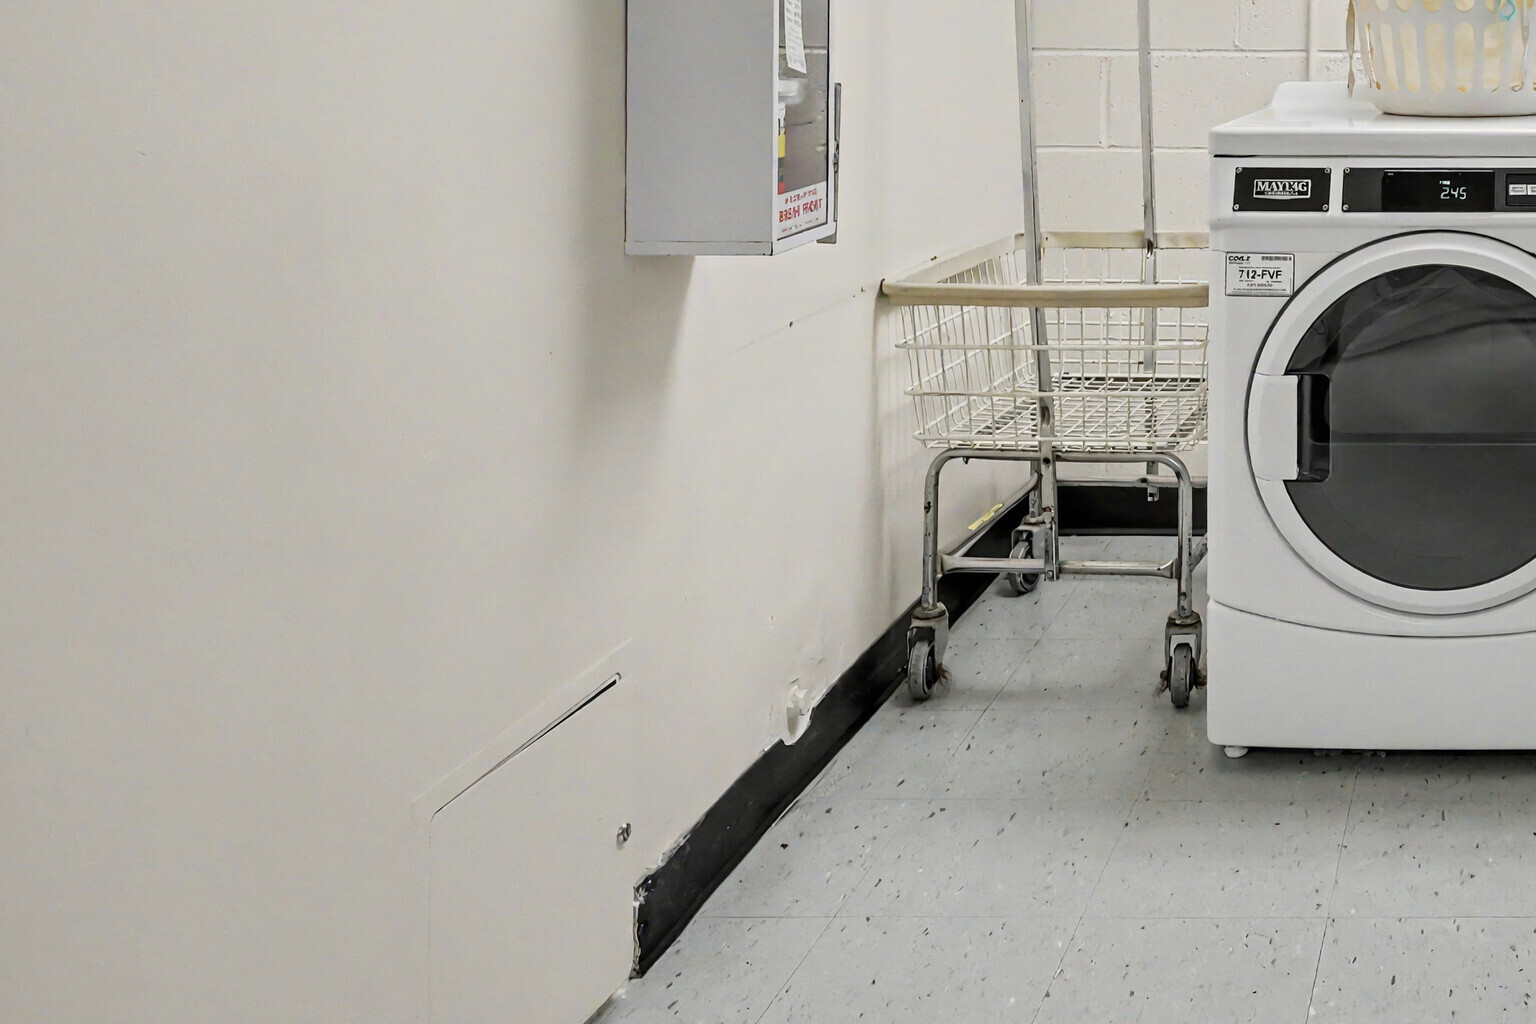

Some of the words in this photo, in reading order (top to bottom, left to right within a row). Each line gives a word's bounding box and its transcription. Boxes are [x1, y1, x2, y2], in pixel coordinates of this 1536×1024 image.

[1256, 180, 1308, 192] MAYTAG
[1440, 186, 1467, 200] 245
[1238, 269, 1283, 280] 712-FVF
